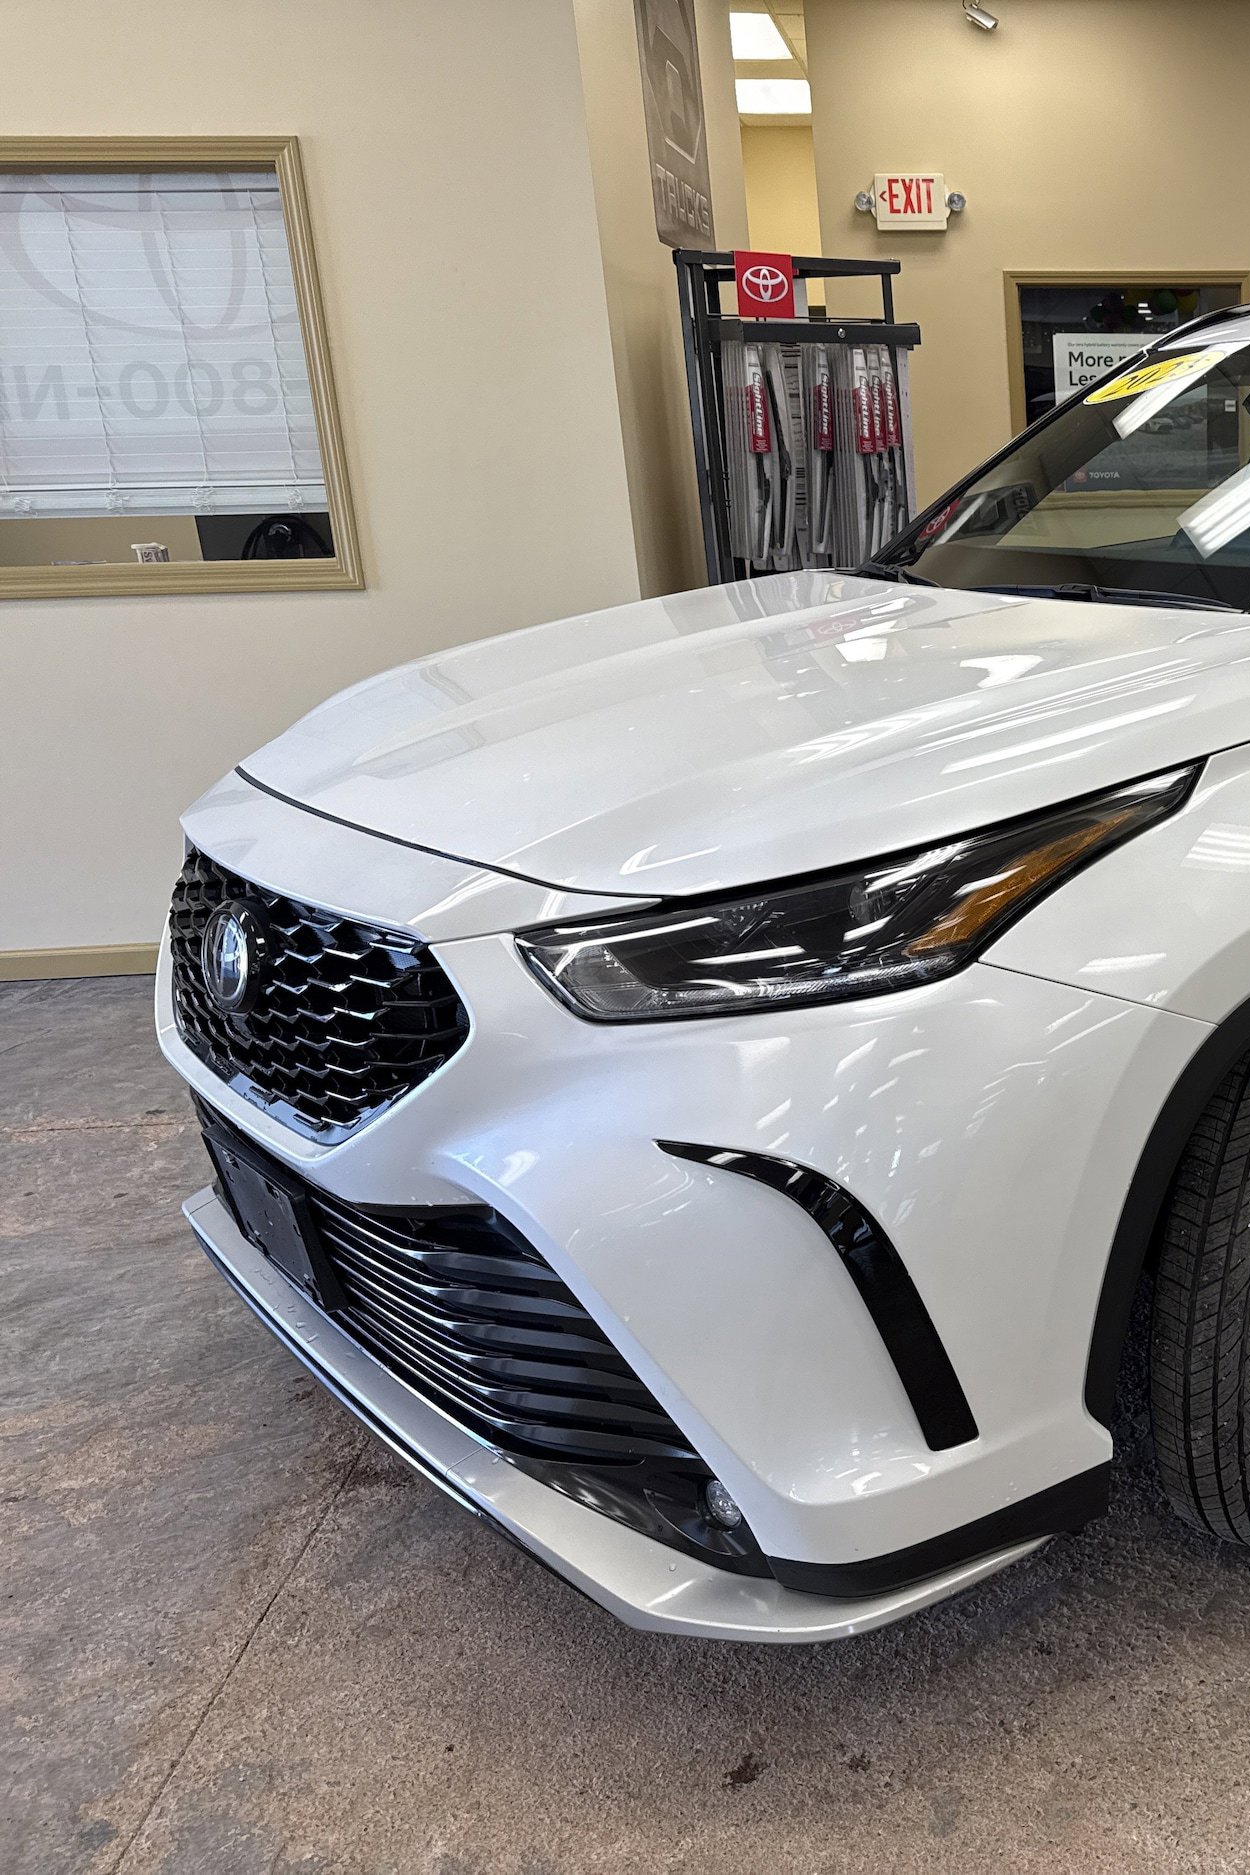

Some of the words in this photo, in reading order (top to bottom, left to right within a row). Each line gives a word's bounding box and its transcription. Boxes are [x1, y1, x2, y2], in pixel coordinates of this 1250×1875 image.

[656, 163, 711, 237] TRUCKS
[887, 178, 935, 214] EXIT
[1068, 351, 1114, 368] More
[1089, 471, 1120, 479] TOYOTA
